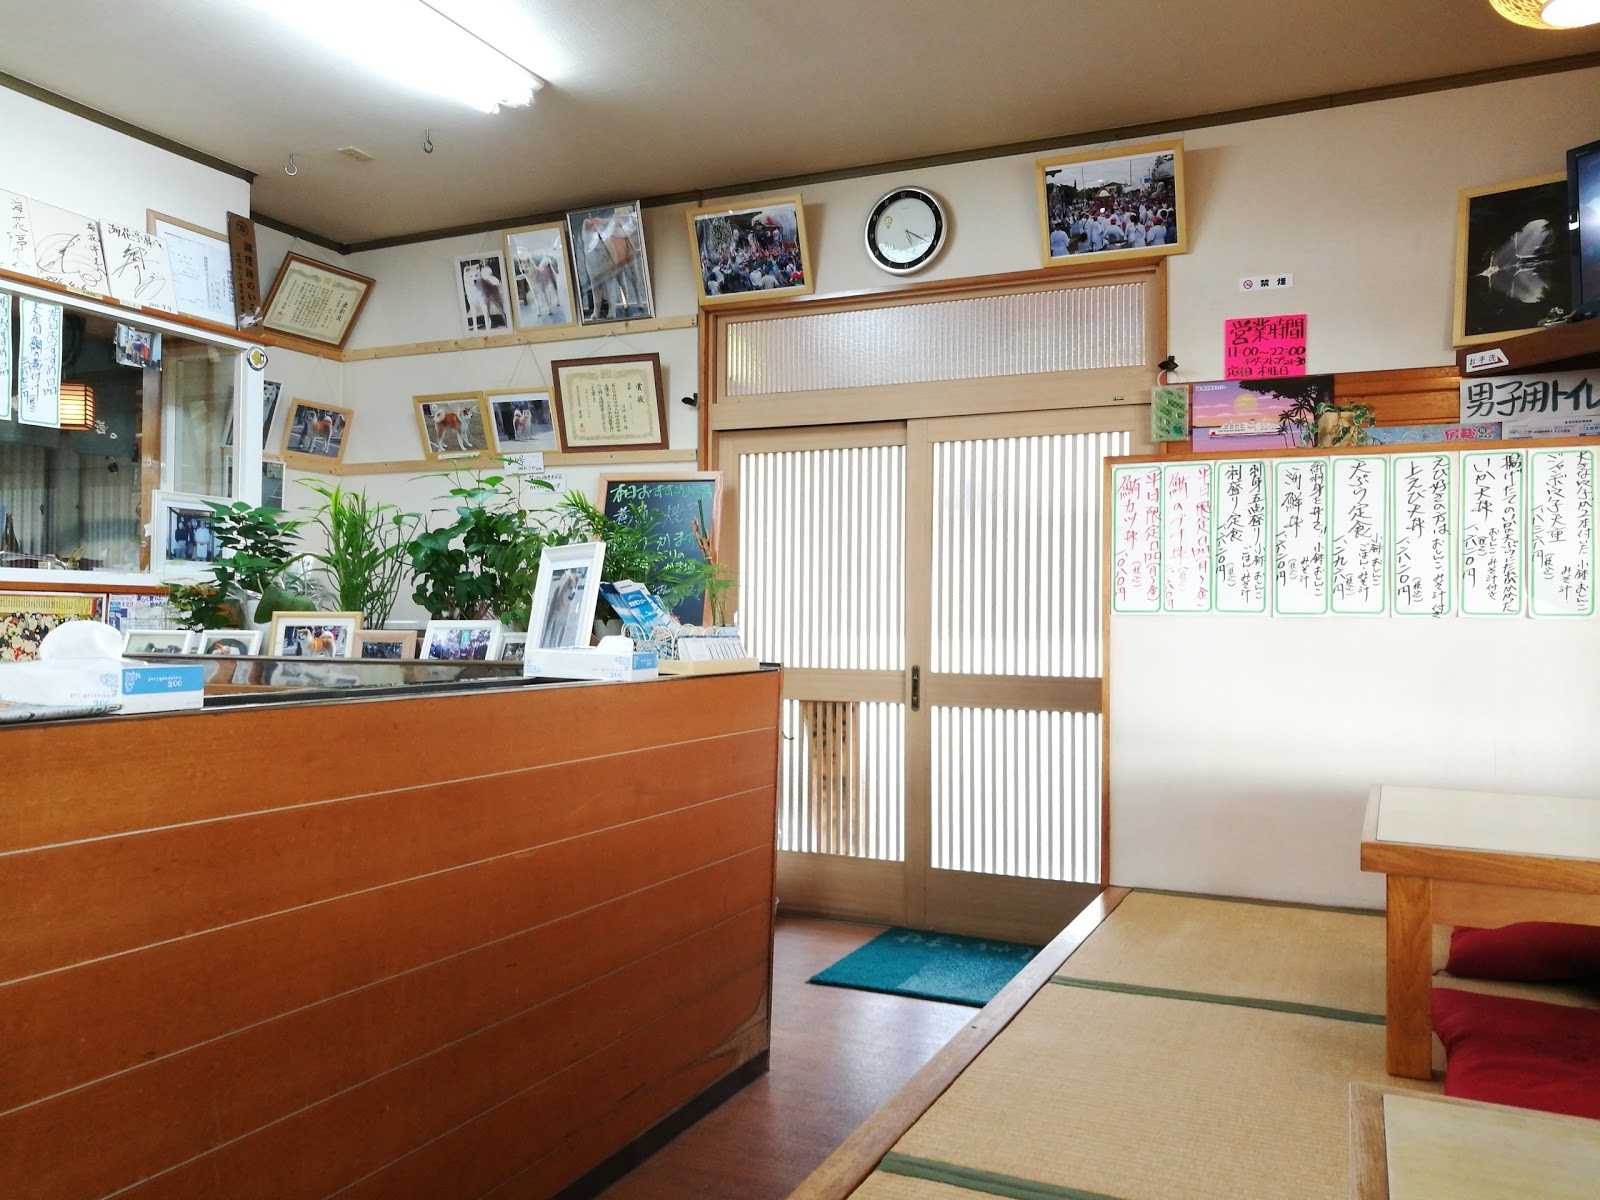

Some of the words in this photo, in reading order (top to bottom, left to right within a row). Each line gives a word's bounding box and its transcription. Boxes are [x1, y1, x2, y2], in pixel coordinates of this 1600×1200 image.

[1260, 277, 1286, 288] 禁煙
[1229, 318, 1305, 345] 営業時間
[1281, 467, 1304, 538] 海鮮丼
[1348, 461, 1373, 539] 天ぷら定食
[1404, 461, 1426, 538] 上えび天丼
[1471, 458, 1496, 522] いか天丼
